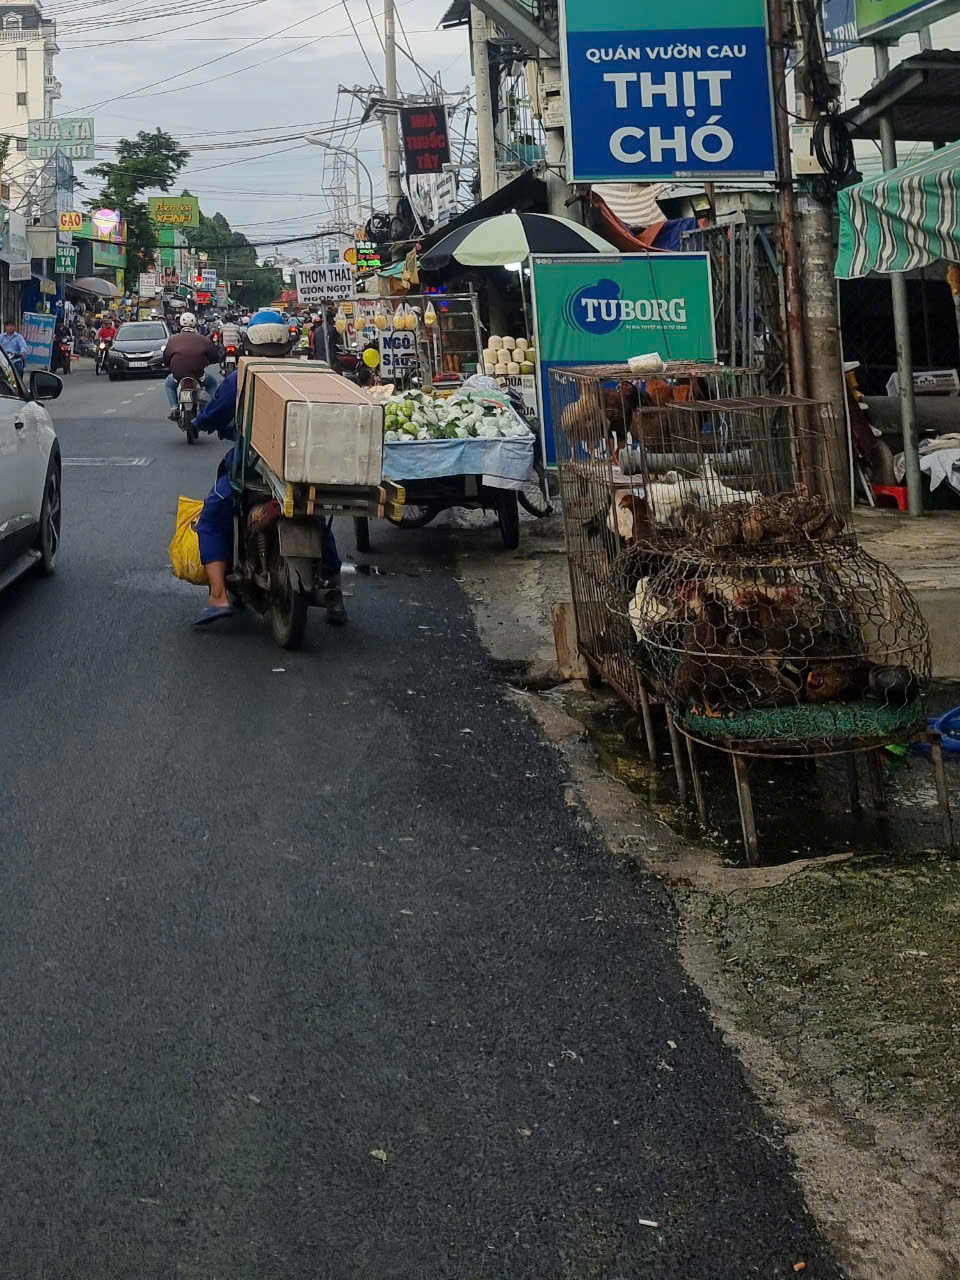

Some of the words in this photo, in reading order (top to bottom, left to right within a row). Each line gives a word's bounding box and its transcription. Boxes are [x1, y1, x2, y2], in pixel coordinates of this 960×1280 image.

[586, 44, 641, 64] QUÁN
[645, 42, 701, 60] VƯỜN
[707, 44, 747, 58] CAU
[603, 70, 732, 118] THỊT
[609, 115, 734, 164] CHÓ
[156, 213, 192, 223] XANH
[299, 270, 327, 284] THƠM
[328, 264, 352, 282] THÁI
[326, 284, 352, 295] NGỌT
[581, 298, 687, 323] TUBORG
